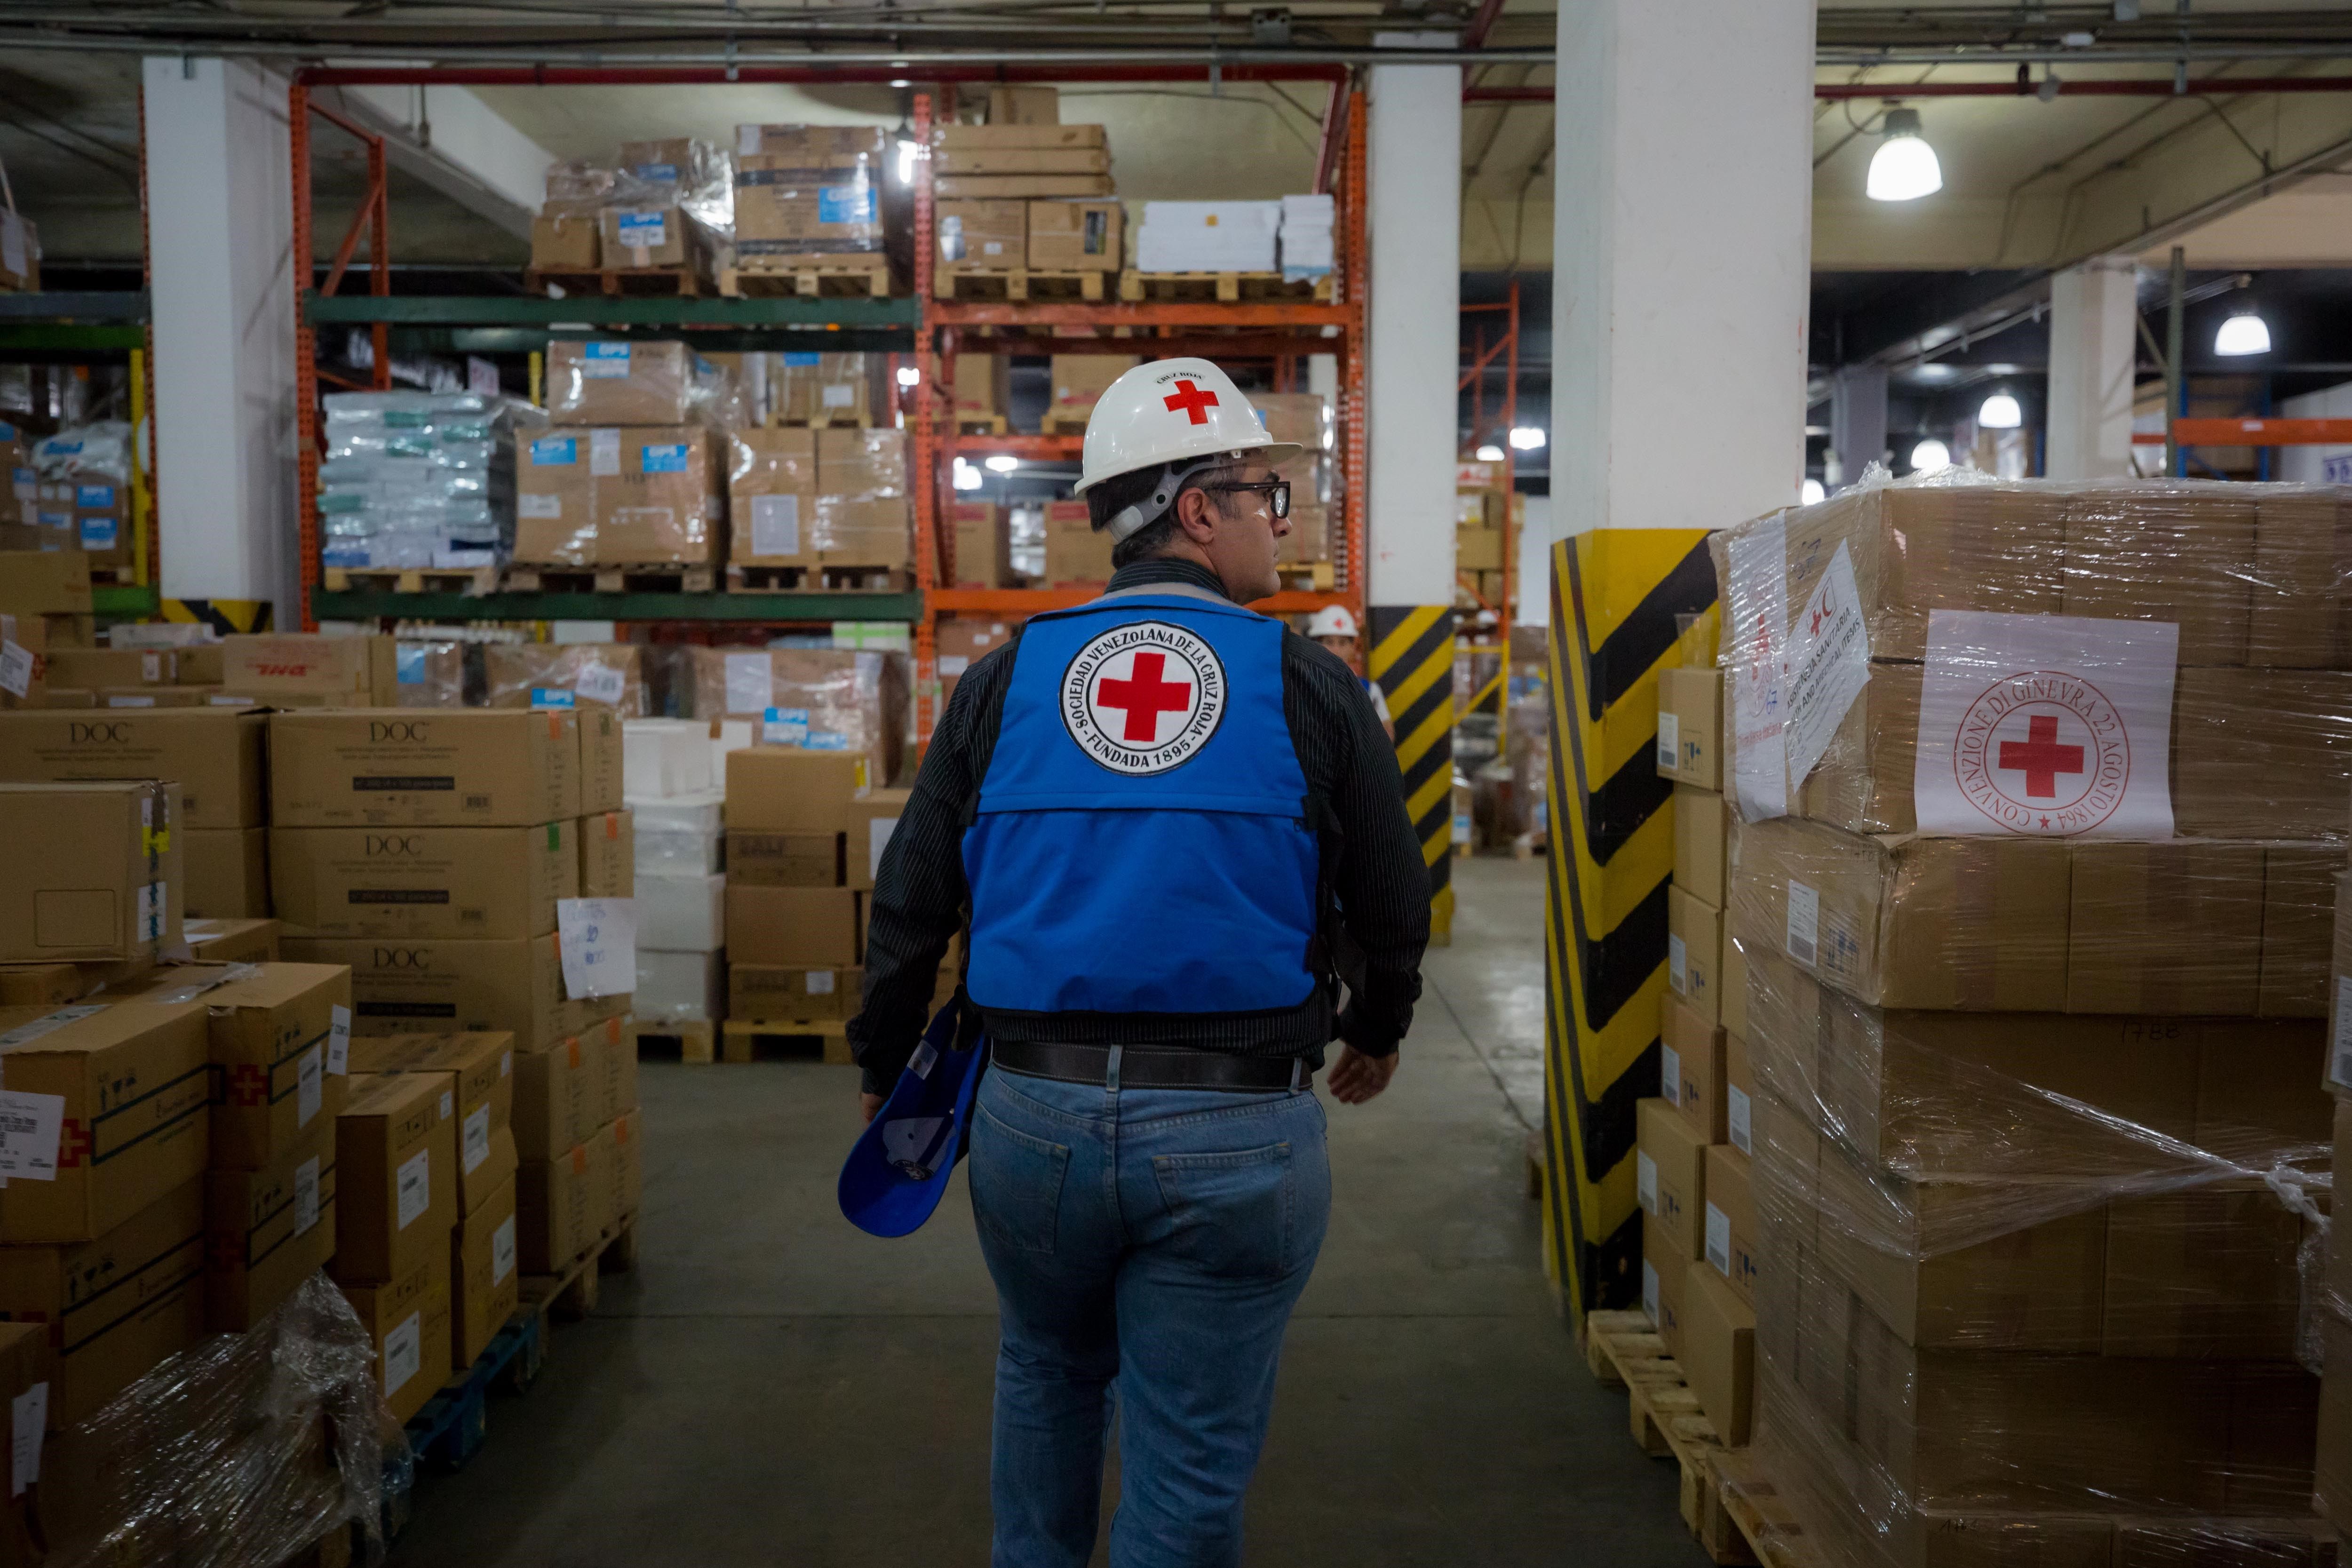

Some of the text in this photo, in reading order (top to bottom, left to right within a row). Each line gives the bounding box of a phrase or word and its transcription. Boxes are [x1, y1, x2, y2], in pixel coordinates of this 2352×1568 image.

[1157, 372, 1177, 384] CRUZ
[1816, 606, 1851, 662] SANITARIA
[1801, 682, 1817, 710] AND
[1841, 617, 1861, 653] ITEMS
[1070, 628, 1218, 739] SOCIEDAD VENEZOLANA DE LA CRUZ ROJA
[1987, 691, 2011, 716] DI
[70, 722, 131, 744] DOC
[370, 721, 427, 743] DOC
[2092, 713, 2116, 736] 22
[1087, 733, 1192, 768] FUNDADA 1895
[1961, 710, 2031, 827] CONVENZIONE
[2089, 740, 2123, 811] AGOSTO
[2057, 803, 2096, 830] 1864
[366, 834, 422, 856] DOC
[373, 947, 430, 970] DOC
